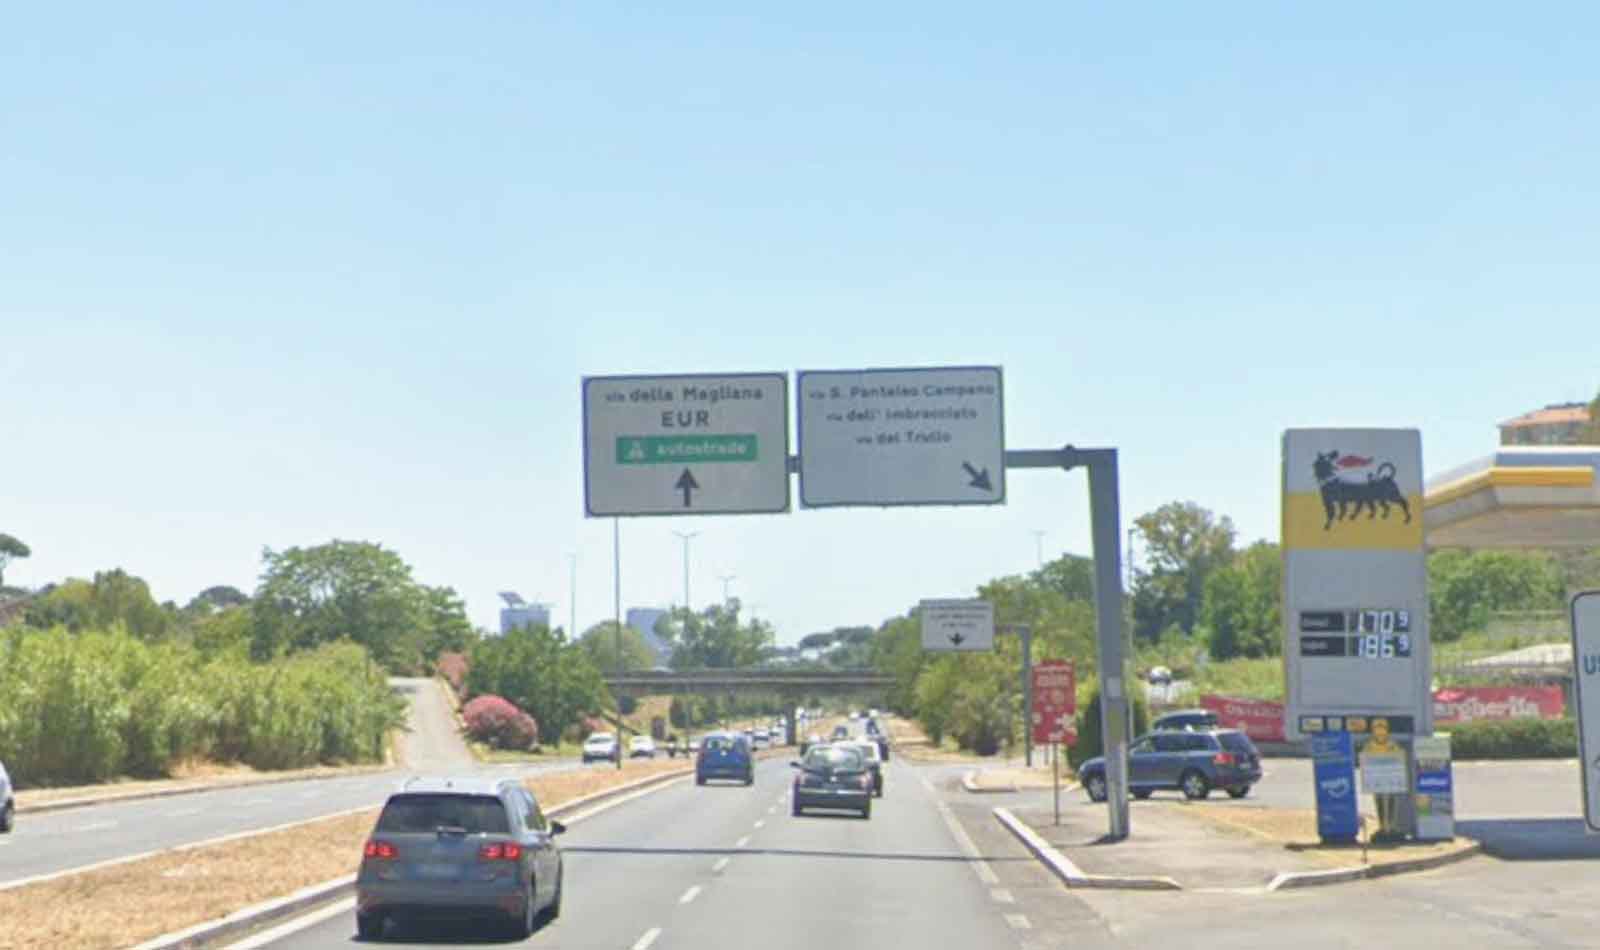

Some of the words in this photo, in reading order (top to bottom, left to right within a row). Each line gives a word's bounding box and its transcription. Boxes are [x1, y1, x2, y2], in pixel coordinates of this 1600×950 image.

[629, 388, 673, 402] della
[683, 385, 763, 404] Magliana
[661, 409, 710, 428] EUR
[656, 440, 748, 456] autostrade
